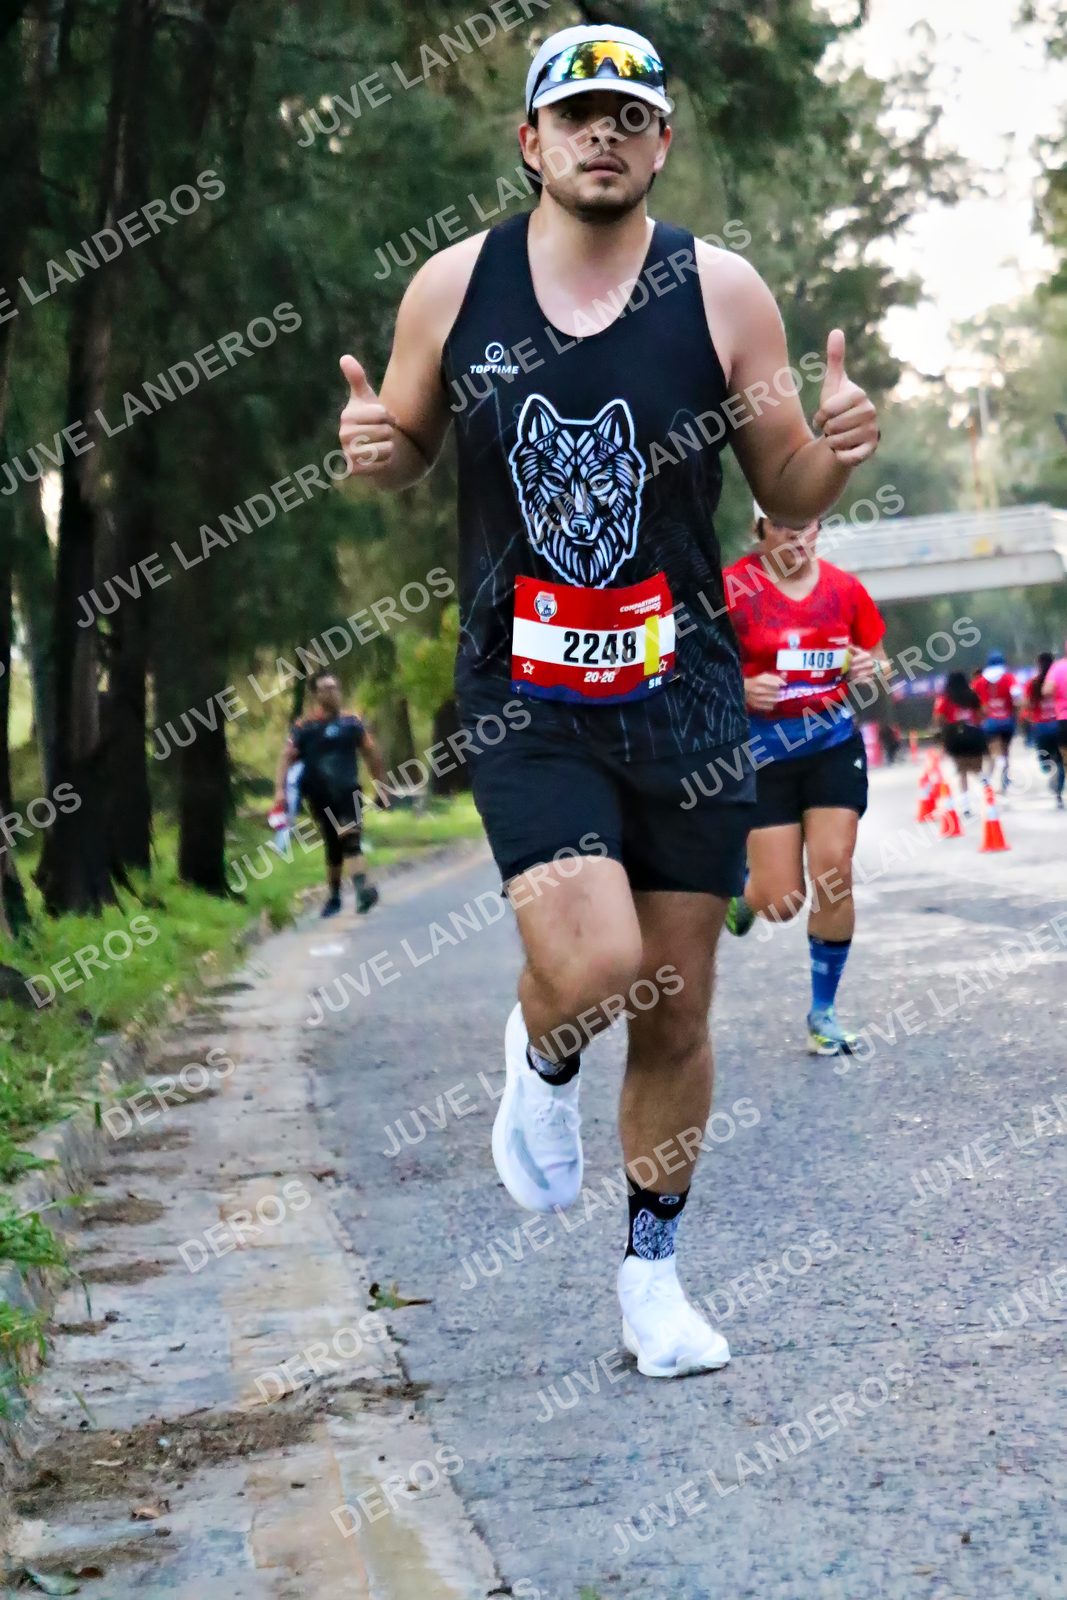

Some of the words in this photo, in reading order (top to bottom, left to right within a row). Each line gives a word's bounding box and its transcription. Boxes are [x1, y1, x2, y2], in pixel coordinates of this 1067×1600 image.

[470, 364, 519, 374] TOPTIME
[563, 631, 637, 665] 2248
[803, 652, 834, 668] 1409
